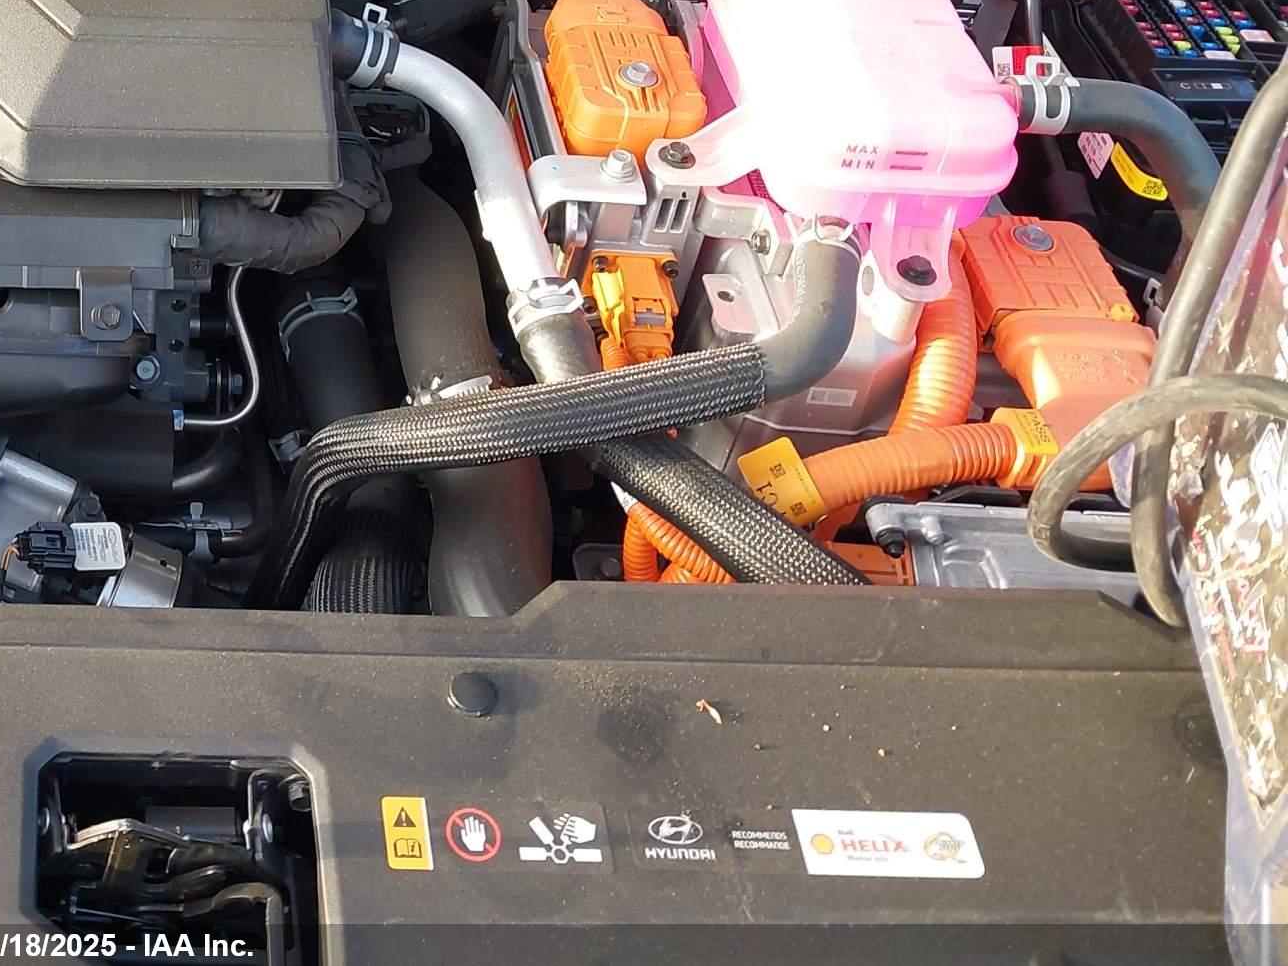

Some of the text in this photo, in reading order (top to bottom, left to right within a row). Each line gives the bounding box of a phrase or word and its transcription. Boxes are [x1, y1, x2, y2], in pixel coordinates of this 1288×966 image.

[845, 144, 879, 154] MAX
[840, 158, 876, 169] MIN
[731, 830, 788, 840] RECOMMENDS
[841, 837, 910, 853] HELIX
[644, 846, 718, 861] HYUNDAI
